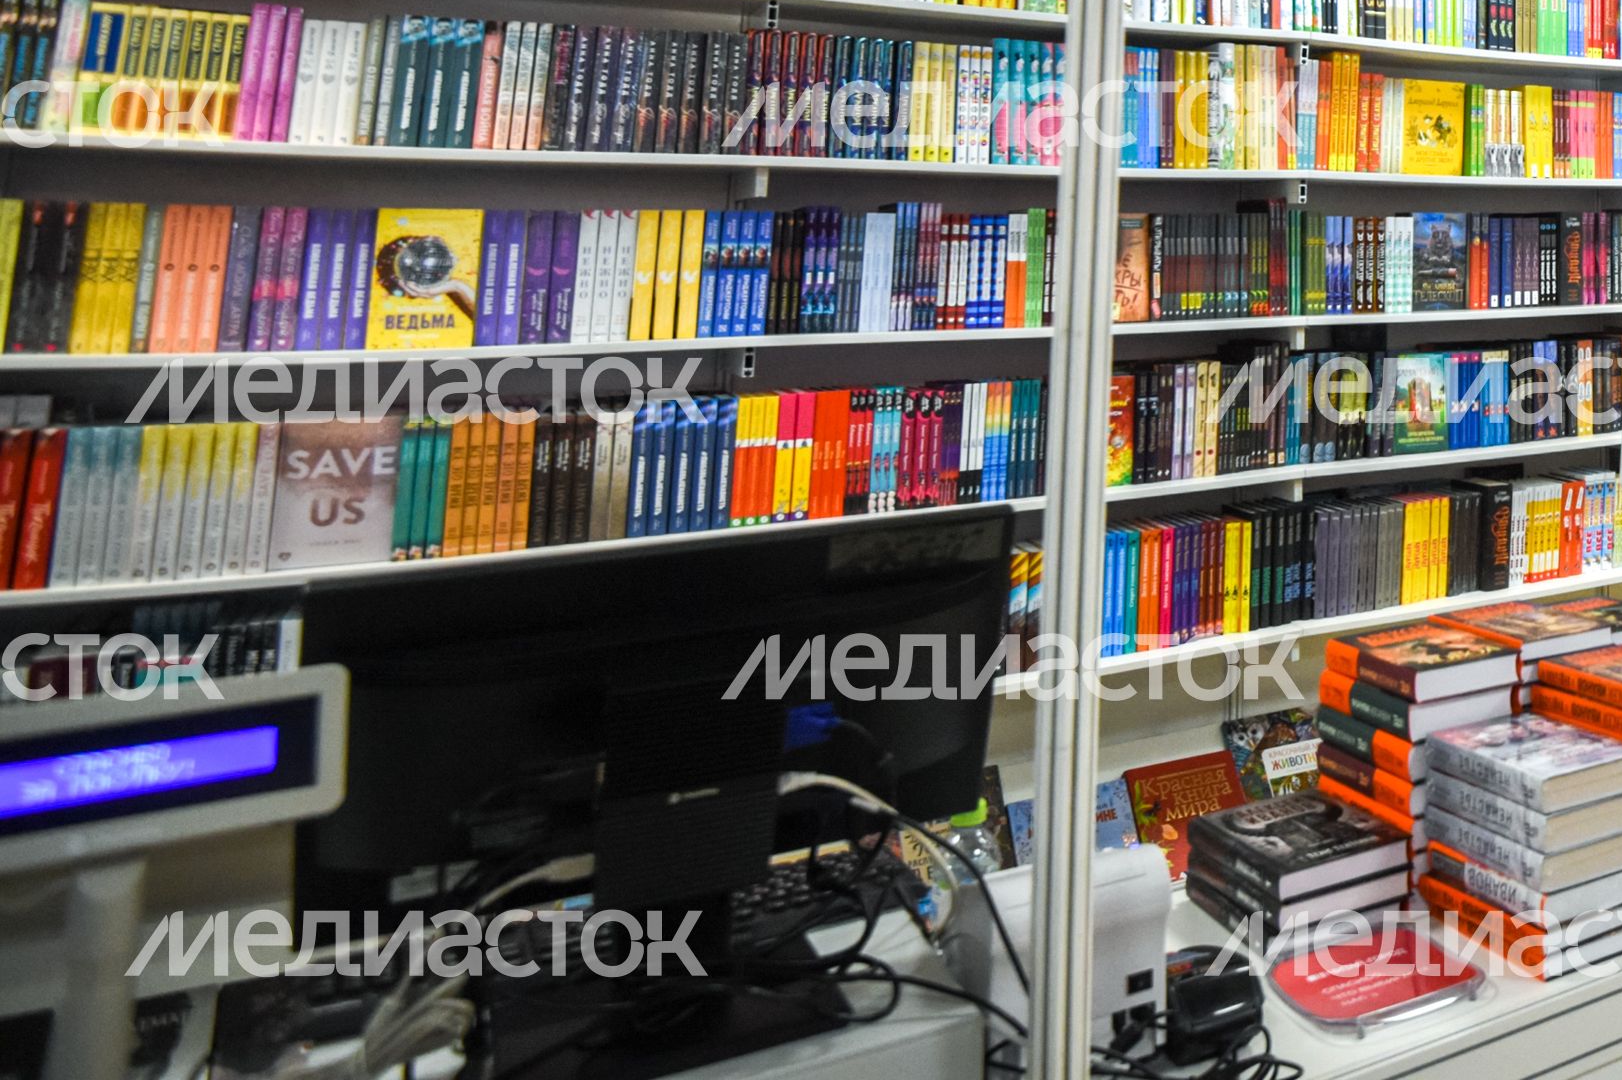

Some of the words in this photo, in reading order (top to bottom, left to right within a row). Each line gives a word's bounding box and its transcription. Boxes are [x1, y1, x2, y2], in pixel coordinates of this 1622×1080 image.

[385, 314, 455, 330] ВЕДЬМА
[286, 445, 398, 480] SAVE
[309, 495, 366, 527] US
[1271, 751, 1317, 770] ЖИВОТН
[1140, 767, 1227, 800] Красная
[1174, 779, 1232, 809] книга
[1166, 798, 1221, 822] мира
[1467, 867, 1517, 904] ИВАНОВ
